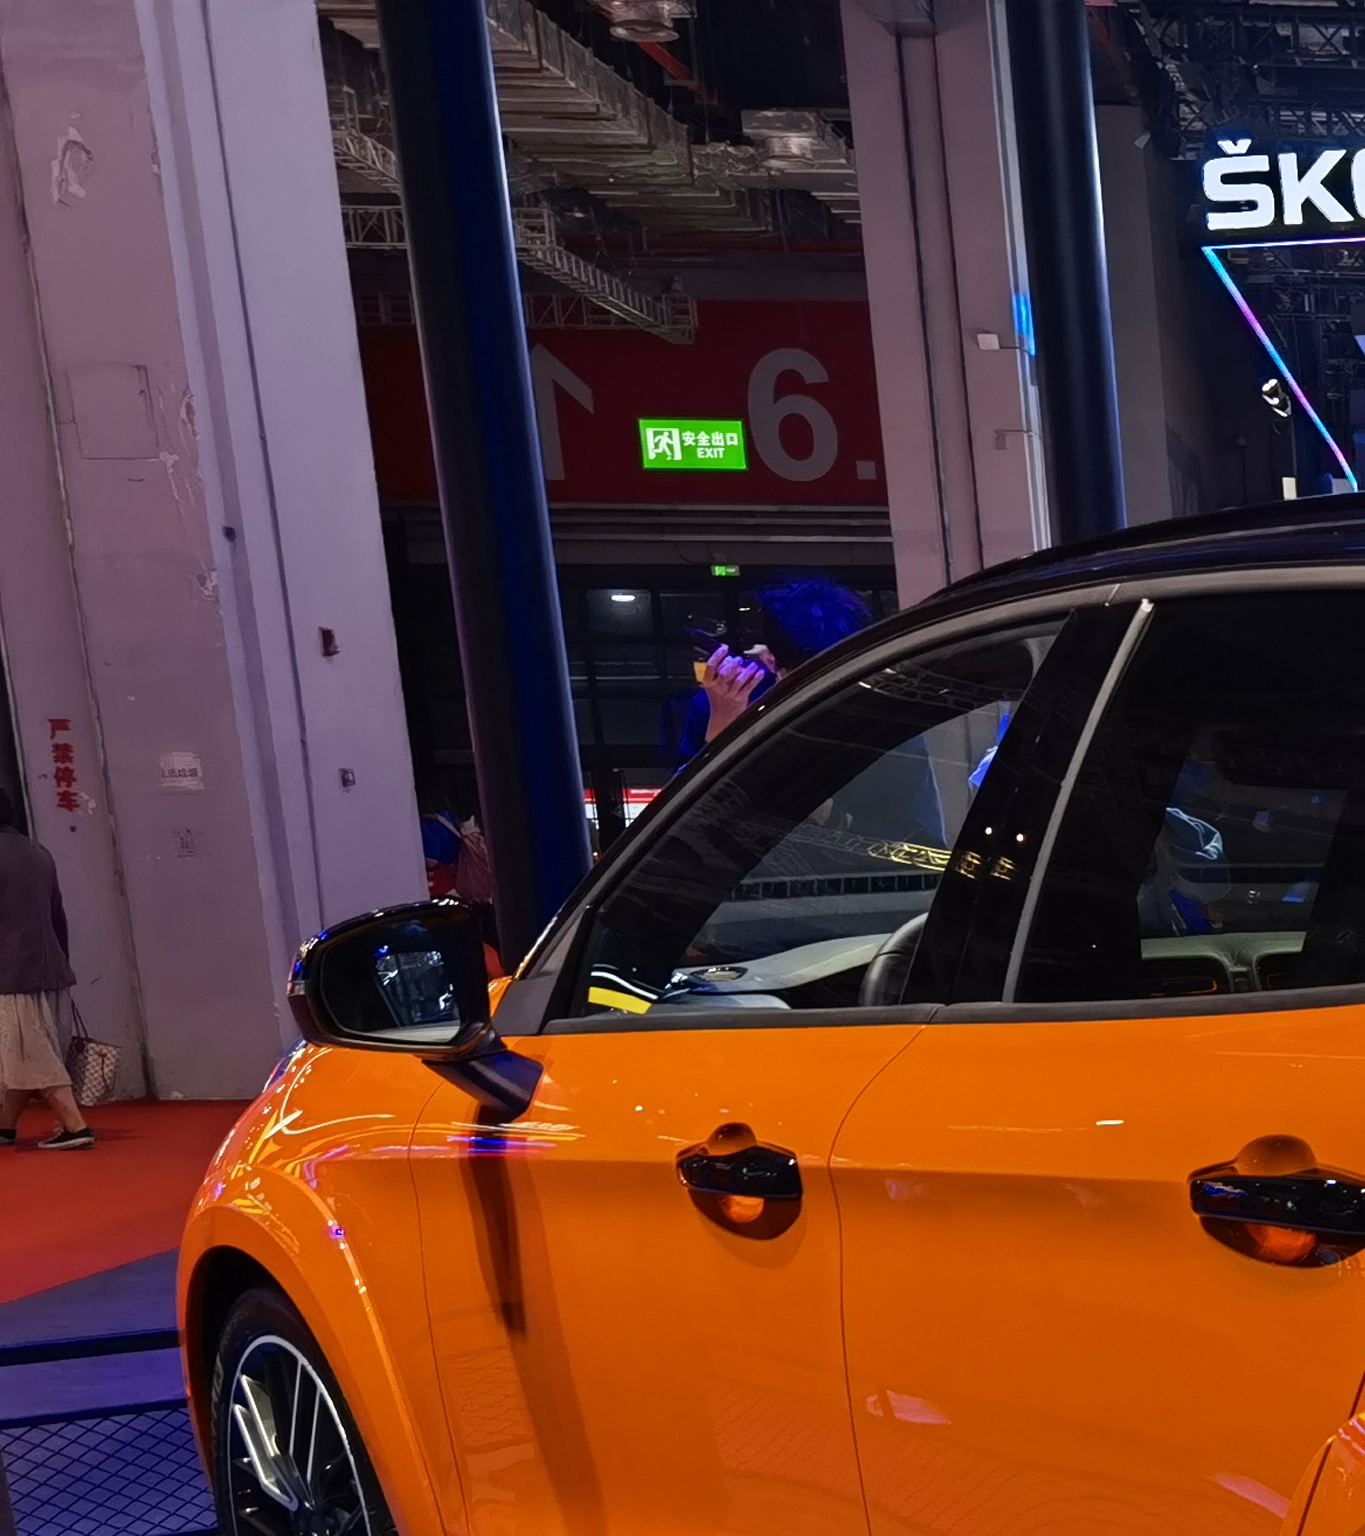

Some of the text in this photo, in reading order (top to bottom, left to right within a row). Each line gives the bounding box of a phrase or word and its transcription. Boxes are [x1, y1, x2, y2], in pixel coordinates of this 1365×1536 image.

[681, 430, 739, 447] 安全出口
[696, 447, 725, 459] EXIT
[47, 718, 80, 812] 严禁停车
